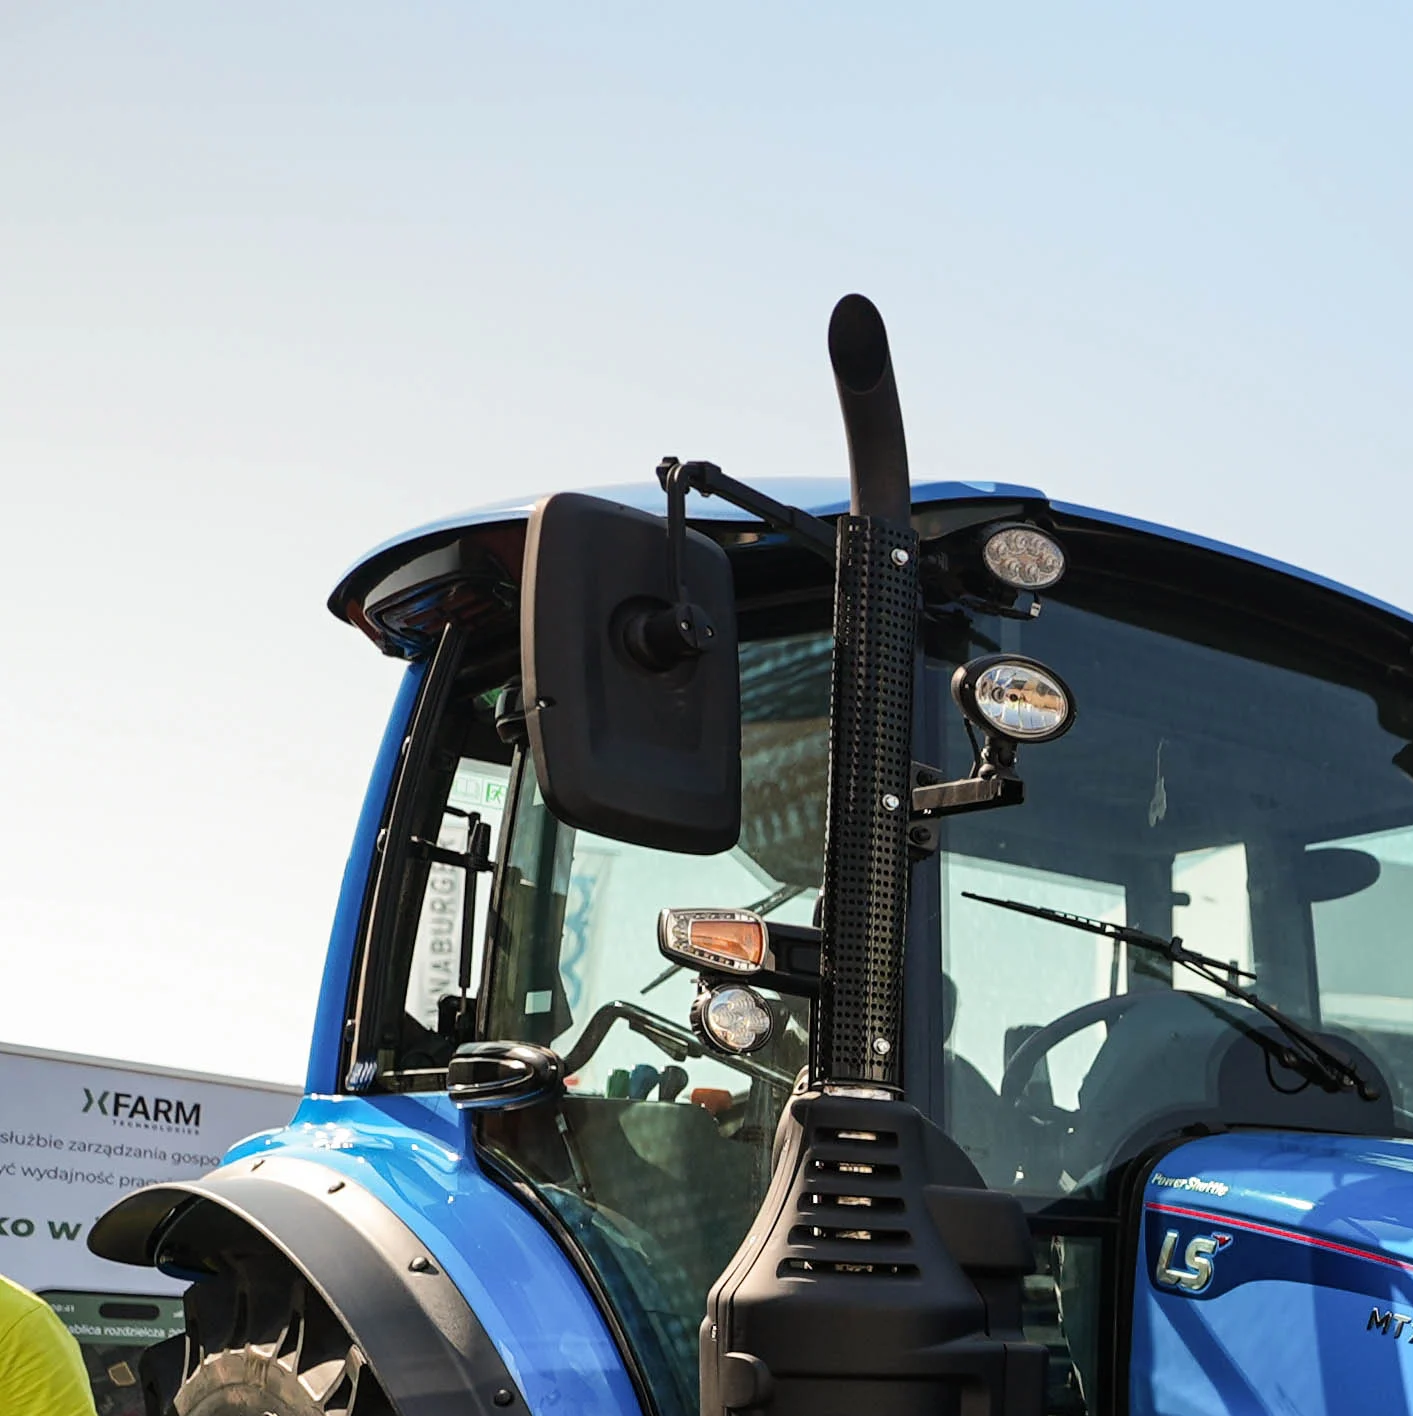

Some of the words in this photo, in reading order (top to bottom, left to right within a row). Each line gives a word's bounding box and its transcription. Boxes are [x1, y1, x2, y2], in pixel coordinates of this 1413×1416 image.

[69, 1140, 167, 1161] zarządzania
[21, 1167, 114, 1185] wydajność
[1156, 1231, 1217, 1290] LS
